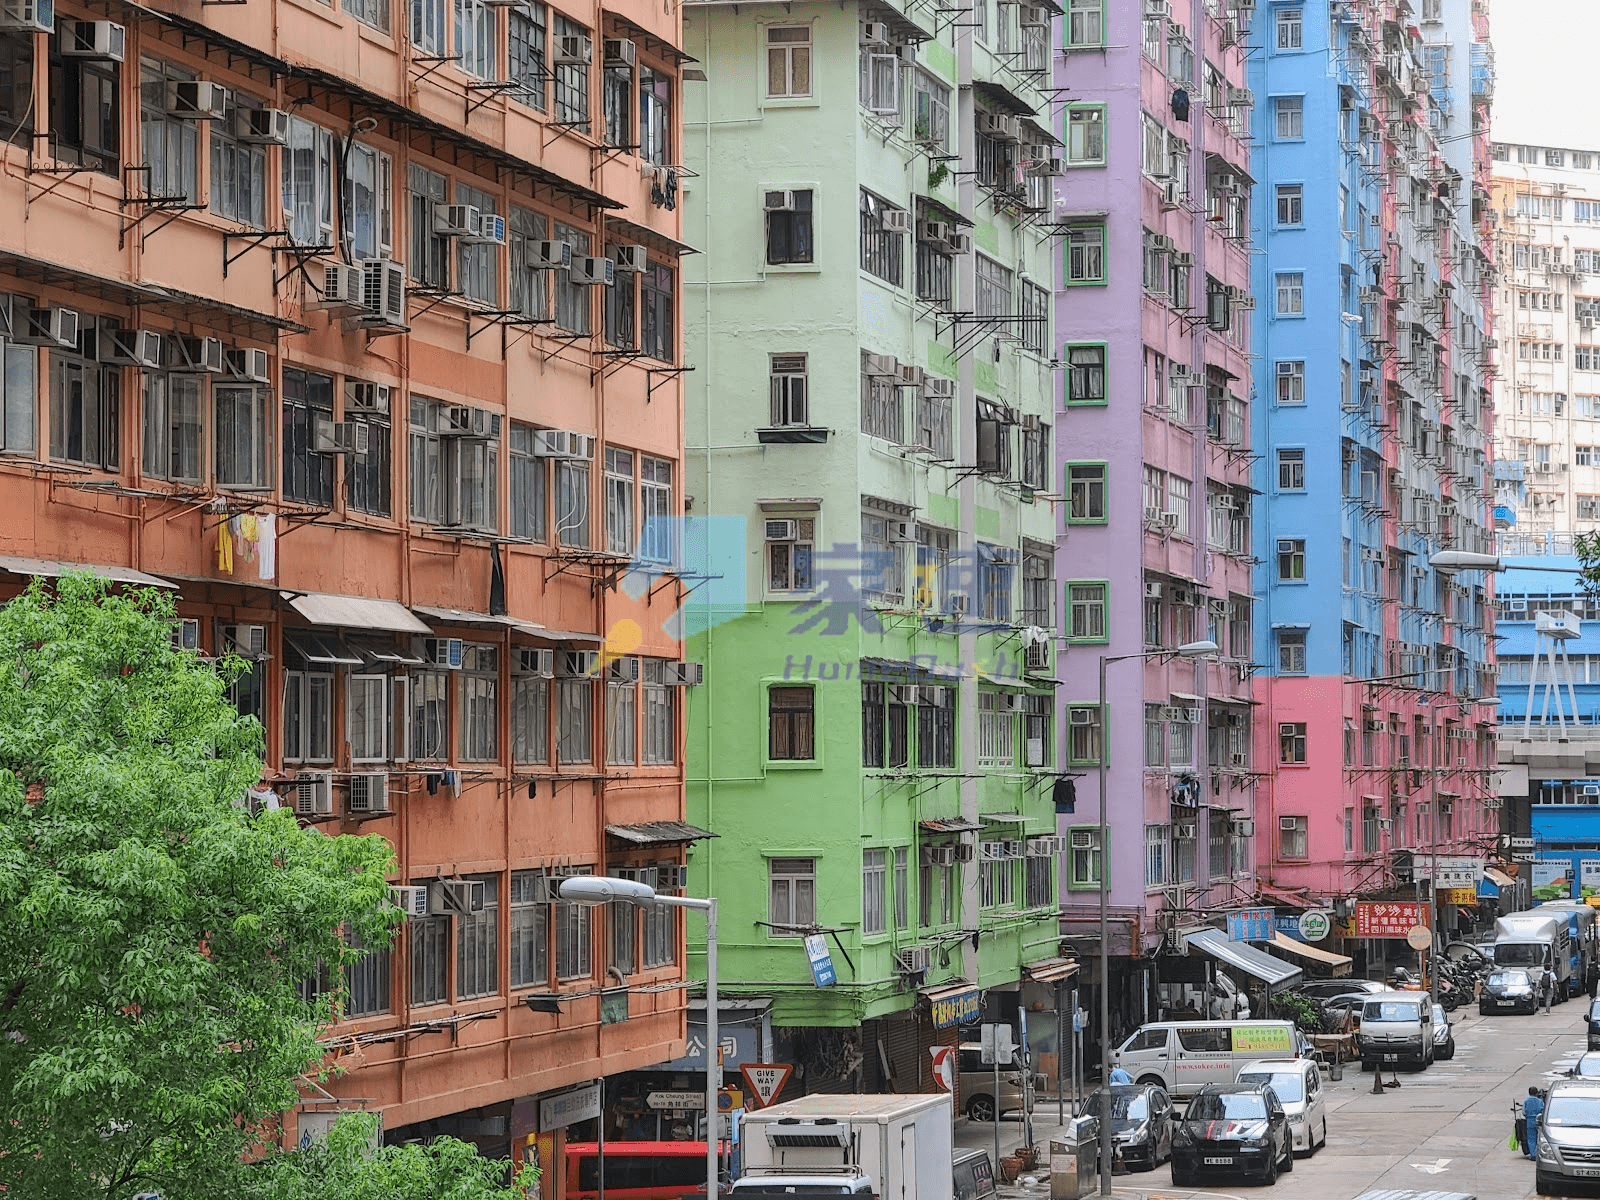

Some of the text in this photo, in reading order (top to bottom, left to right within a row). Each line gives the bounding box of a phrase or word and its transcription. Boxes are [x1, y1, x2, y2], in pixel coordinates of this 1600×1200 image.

[1371, 926, 1410, 934] 四川風味水
[686, 1035, 737, 1058] 公司
